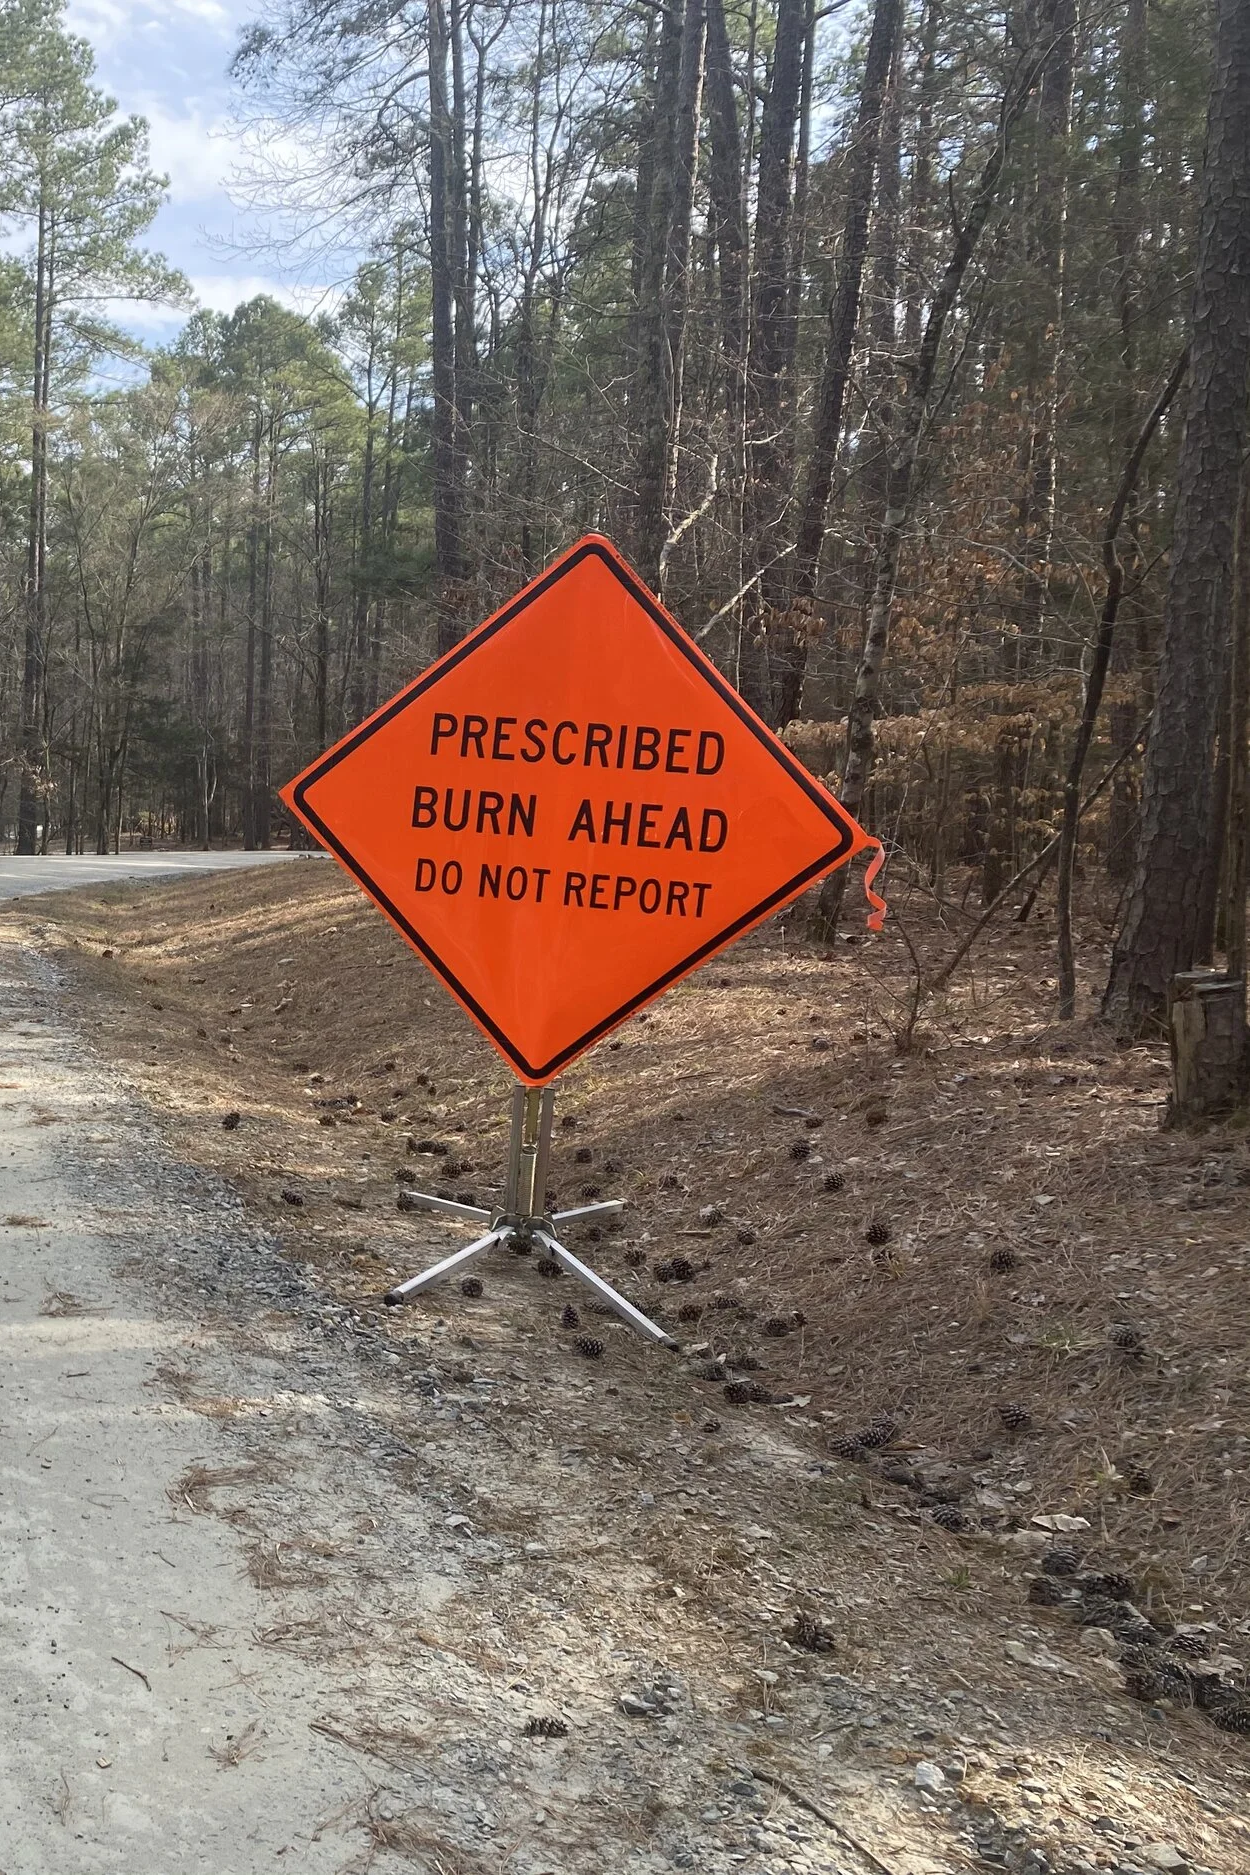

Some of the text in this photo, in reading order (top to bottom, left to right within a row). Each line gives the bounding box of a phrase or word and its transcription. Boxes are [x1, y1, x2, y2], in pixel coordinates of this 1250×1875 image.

[430, 712, 725, 776] PRESCRIBED
[411, 785, 728, 853] BURN AHEAD
[414, 857, 713, 918] DO NOT REPORT
